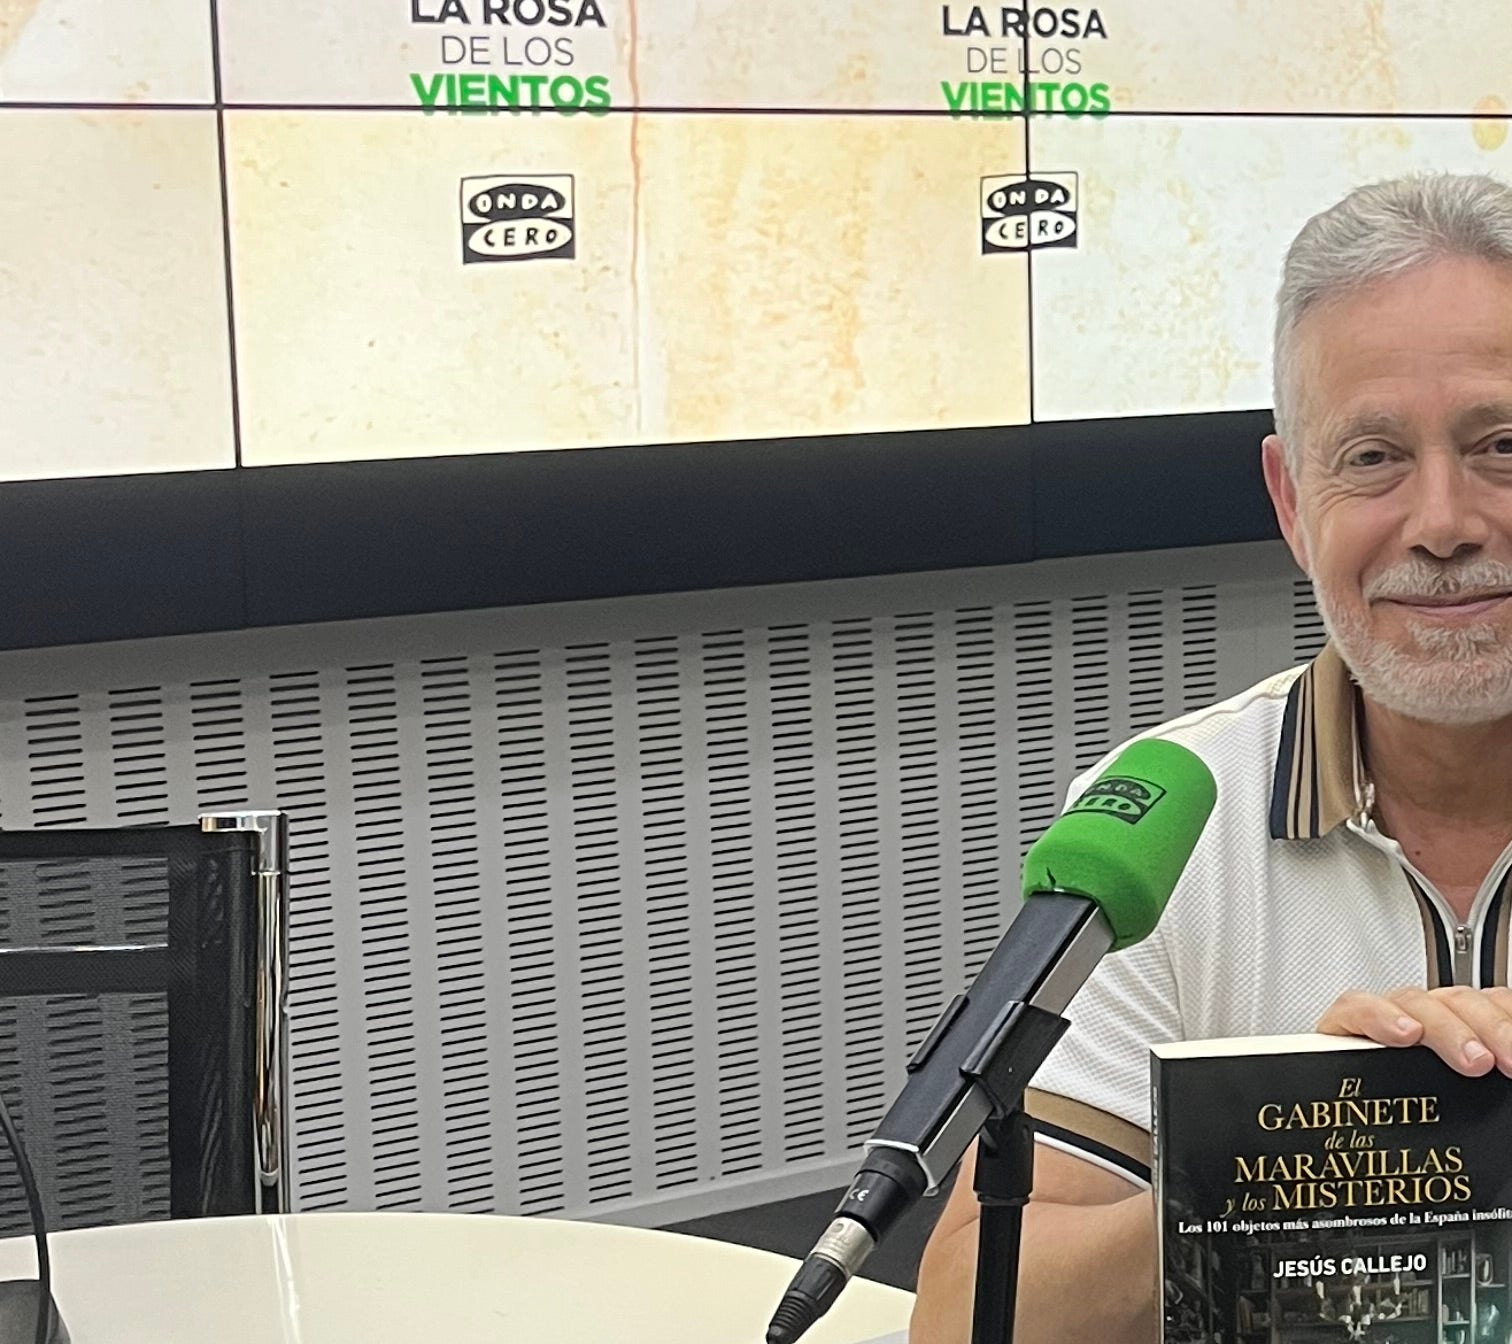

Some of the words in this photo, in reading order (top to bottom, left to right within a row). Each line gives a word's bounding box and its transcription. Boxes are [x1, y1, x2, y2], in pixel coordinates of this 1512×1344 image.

[942, 5, 991, 37] LA
[1001, 7, 1108, 39] ROSA
[441, 35, 491, 64] DE
[503, 36, 575, 66] LOS
[967, 47, 1008, 74] DE
[1018, 48, 1082, 74] LOS
[409, 73, 611, 117] VIENTOS
[940, 81, 1111, 120] VIENTOS
[476, 193, 558, 213] ONDA
[992, 188, 1065, 209] ONDA
[484, 227, 558, 247] CERO
[998, 220, 1064, 239] CERO
[1338, 1077, 1362, 1098] El
[1257, 1096, 1440, 1131] GABINETE
[1325, 1131, 1345, 1150] de
[1350, 1129, 1375, 1148] las
[1234, 1146, 1464, 1183] MARAVILLAS
[1219, 1198, 1237, 1219] y
[1242, 1192, 1266, 1212] los
[1272, 1175, 1472, 1211] MISTERIOS
[1178, 1221, 1203, 1234] Los
[1206, 1220, 1229, 1233] 101
[1232, 1220, 1281, 1236] objetos
[1282, 1218, 1310, 1231] más
[1311, 1214, 1388, 1230] asombrosos
[1389, 1213, 1407, 1226] de
[1409, 1212, 1422, 1225] la
[1424, 1210, 1470, 1227] España
[1273, 1255, 1336, 1278] JESÚS
[1341, 1254, 1427, 1275] CALLEJO
